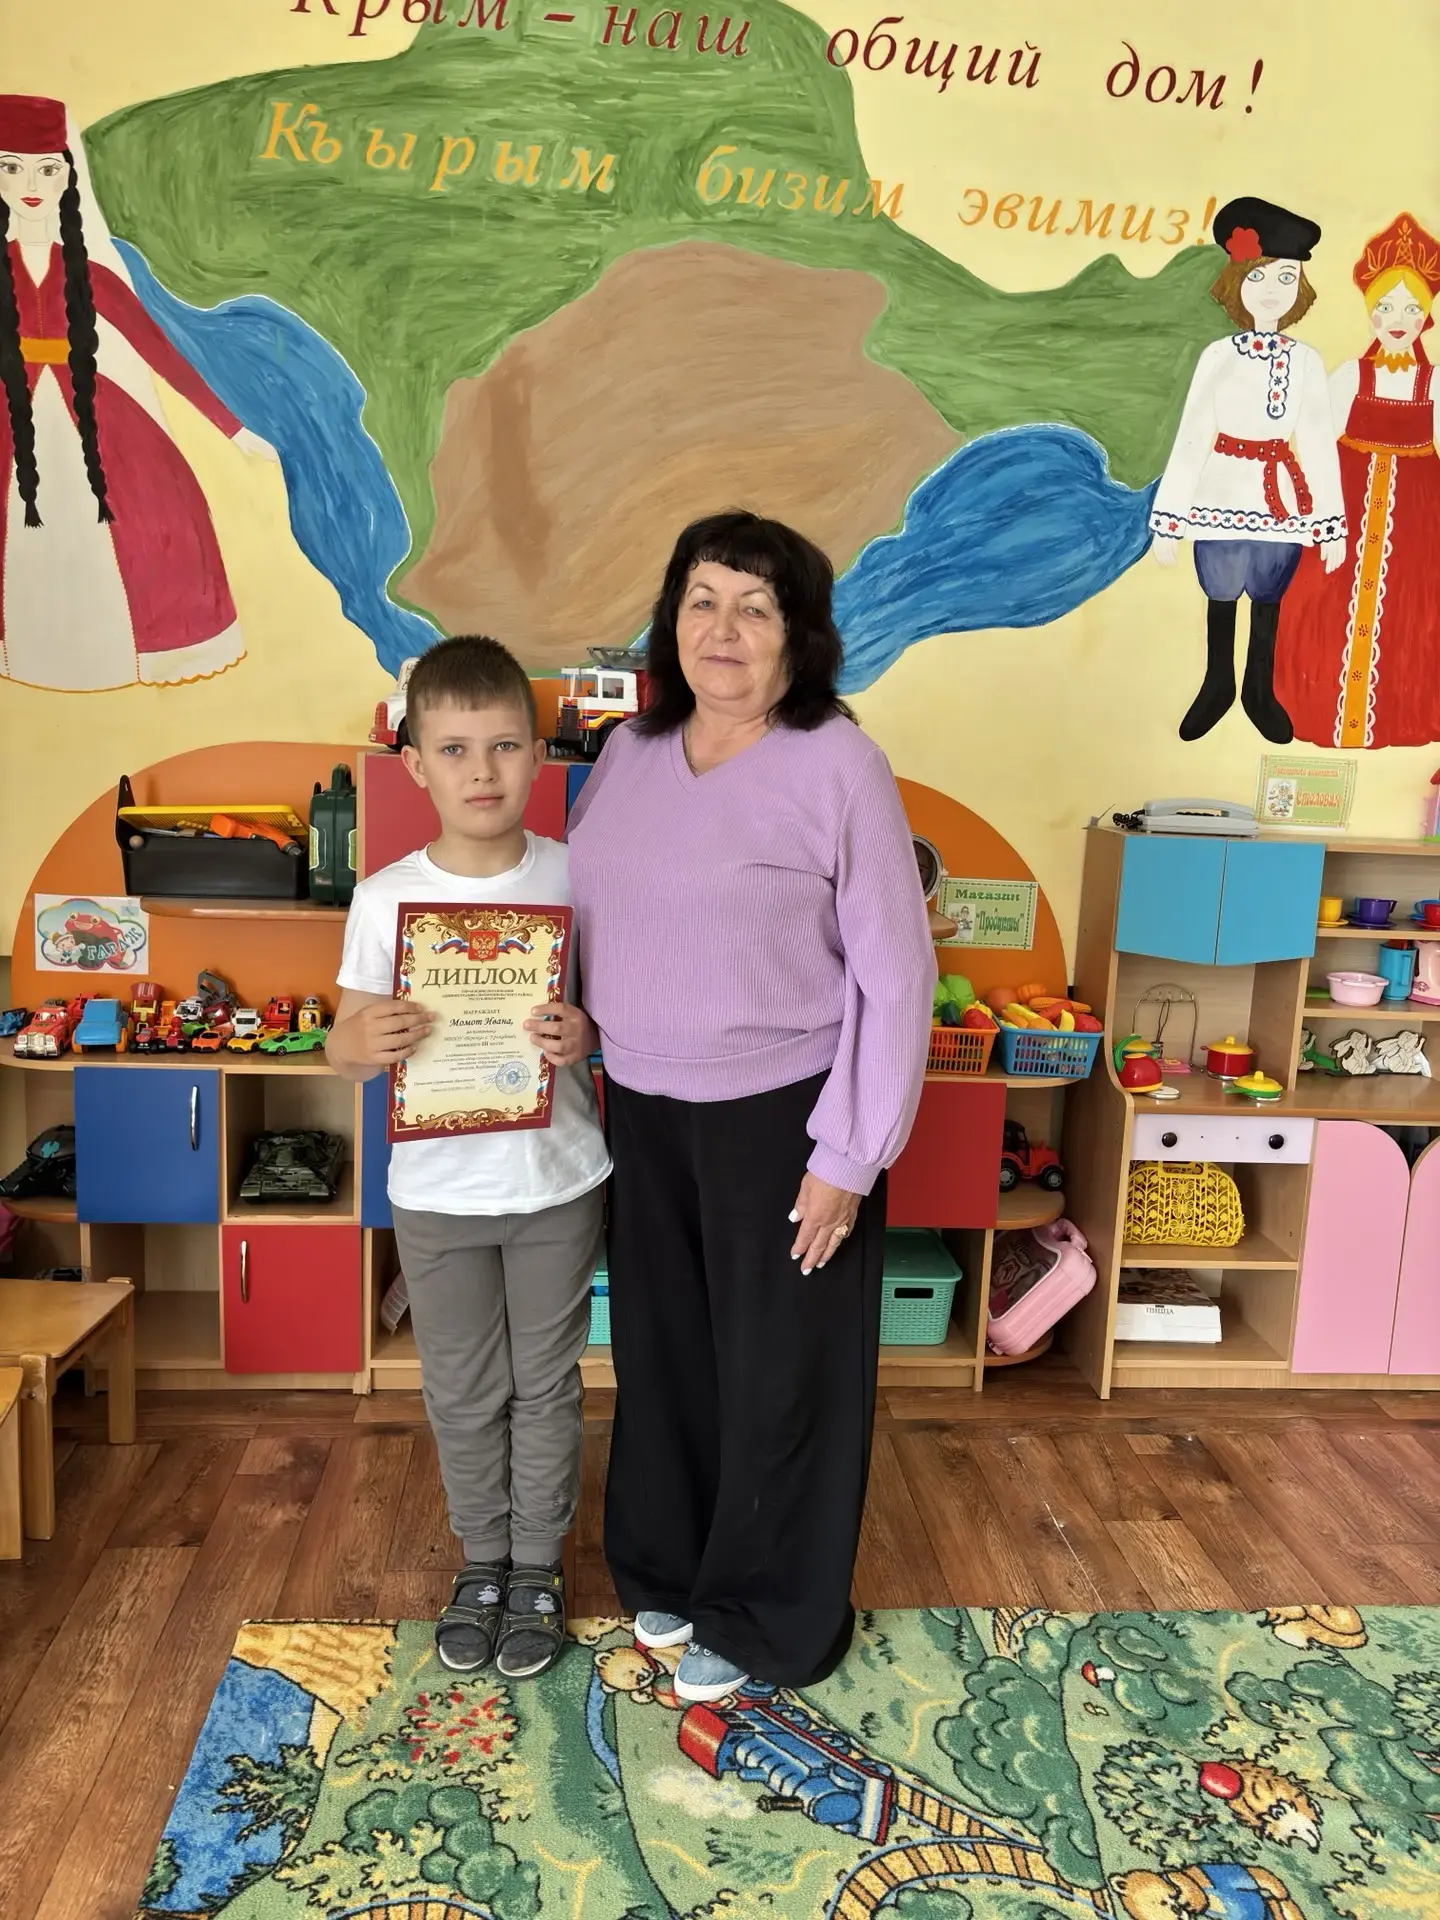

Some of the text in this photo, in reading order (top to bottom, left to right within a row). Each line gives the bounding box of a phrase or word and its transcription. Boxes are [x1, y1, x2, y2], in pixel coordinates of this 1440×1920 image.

[290, 0, 509, 37] рым
[602, 3, 752, 58] наш
[826, 16, 1042, 93] общий
[697, 145, 904, 218] бизим
[957, 187, 1217, 247] эвимиз!
[955, 888, 1020, 902] Магазин
[87, 927, 143, 961] ГАРАЖ
[422, 967, 538, 988] ДИПЛОМ
[449, 1018, 483, 1028] Момот
